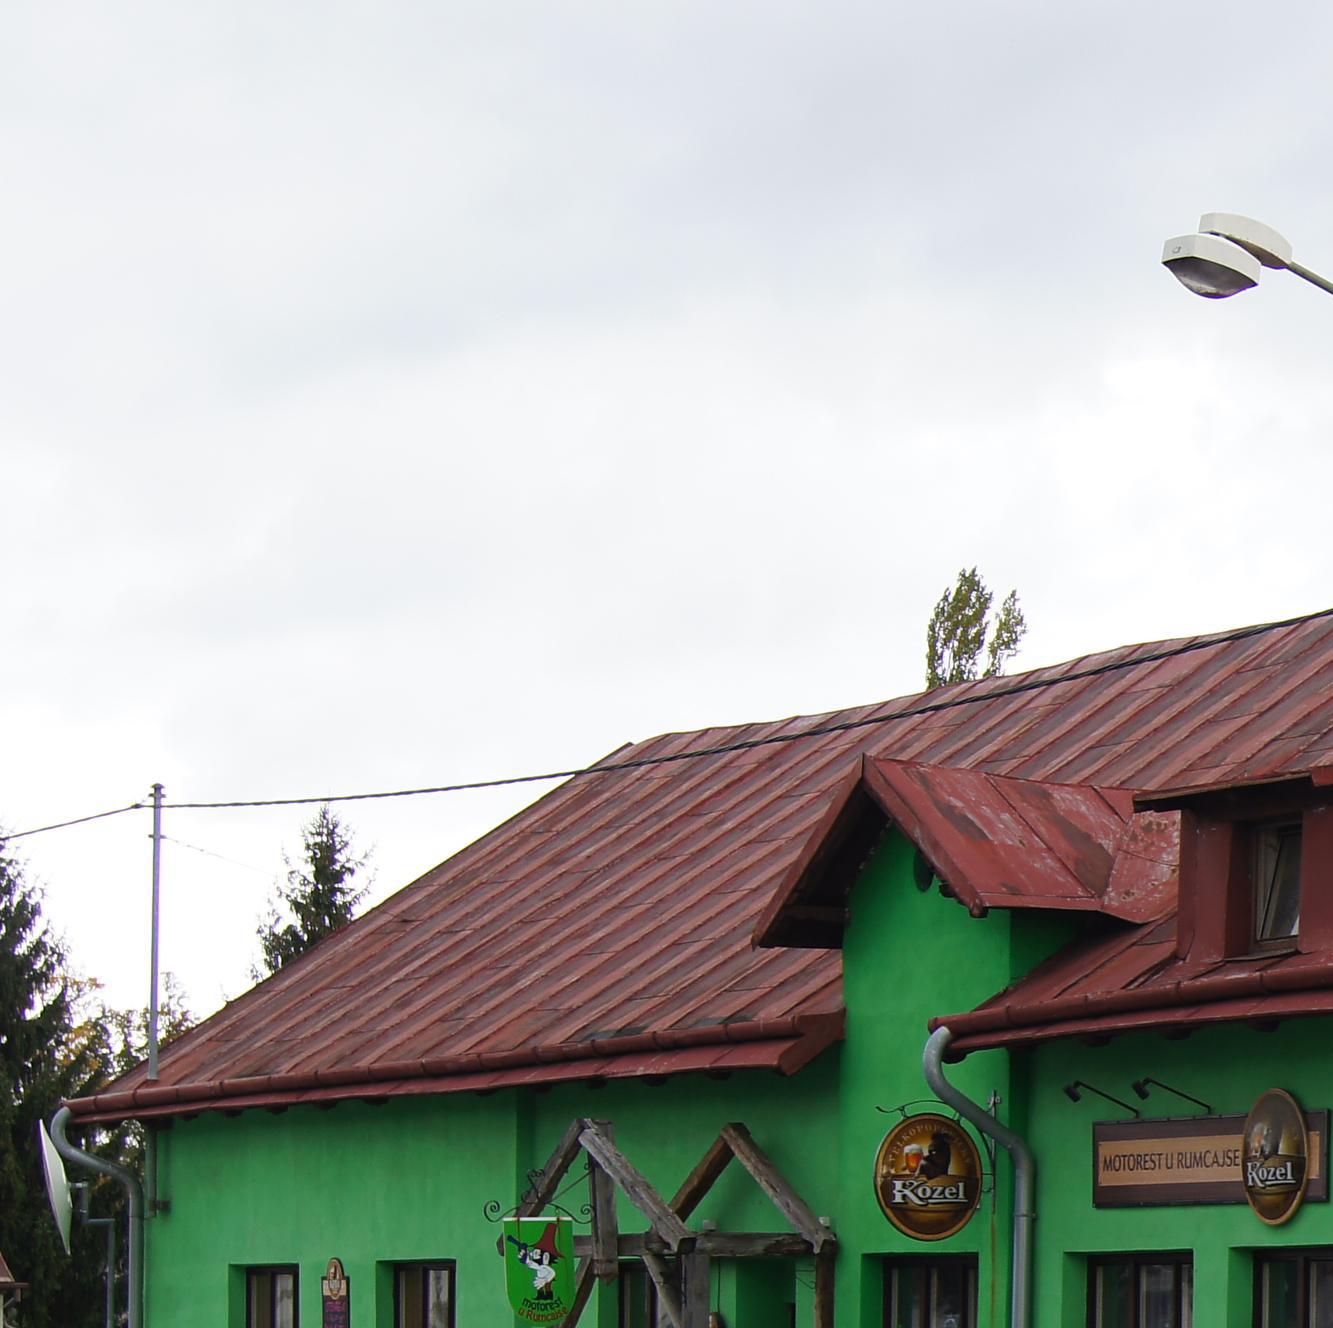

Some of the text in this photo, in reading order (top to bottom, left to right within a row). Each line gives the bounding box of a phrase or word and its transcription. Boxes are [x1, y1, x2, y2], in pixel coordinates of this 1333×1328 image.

[1103, 1149, 1240, 1172] MOTOREST U RUMCAJSE
[1247, 1161, 1296, 1188] Kozel
[892, 1180, 968, 1206] Kozel
